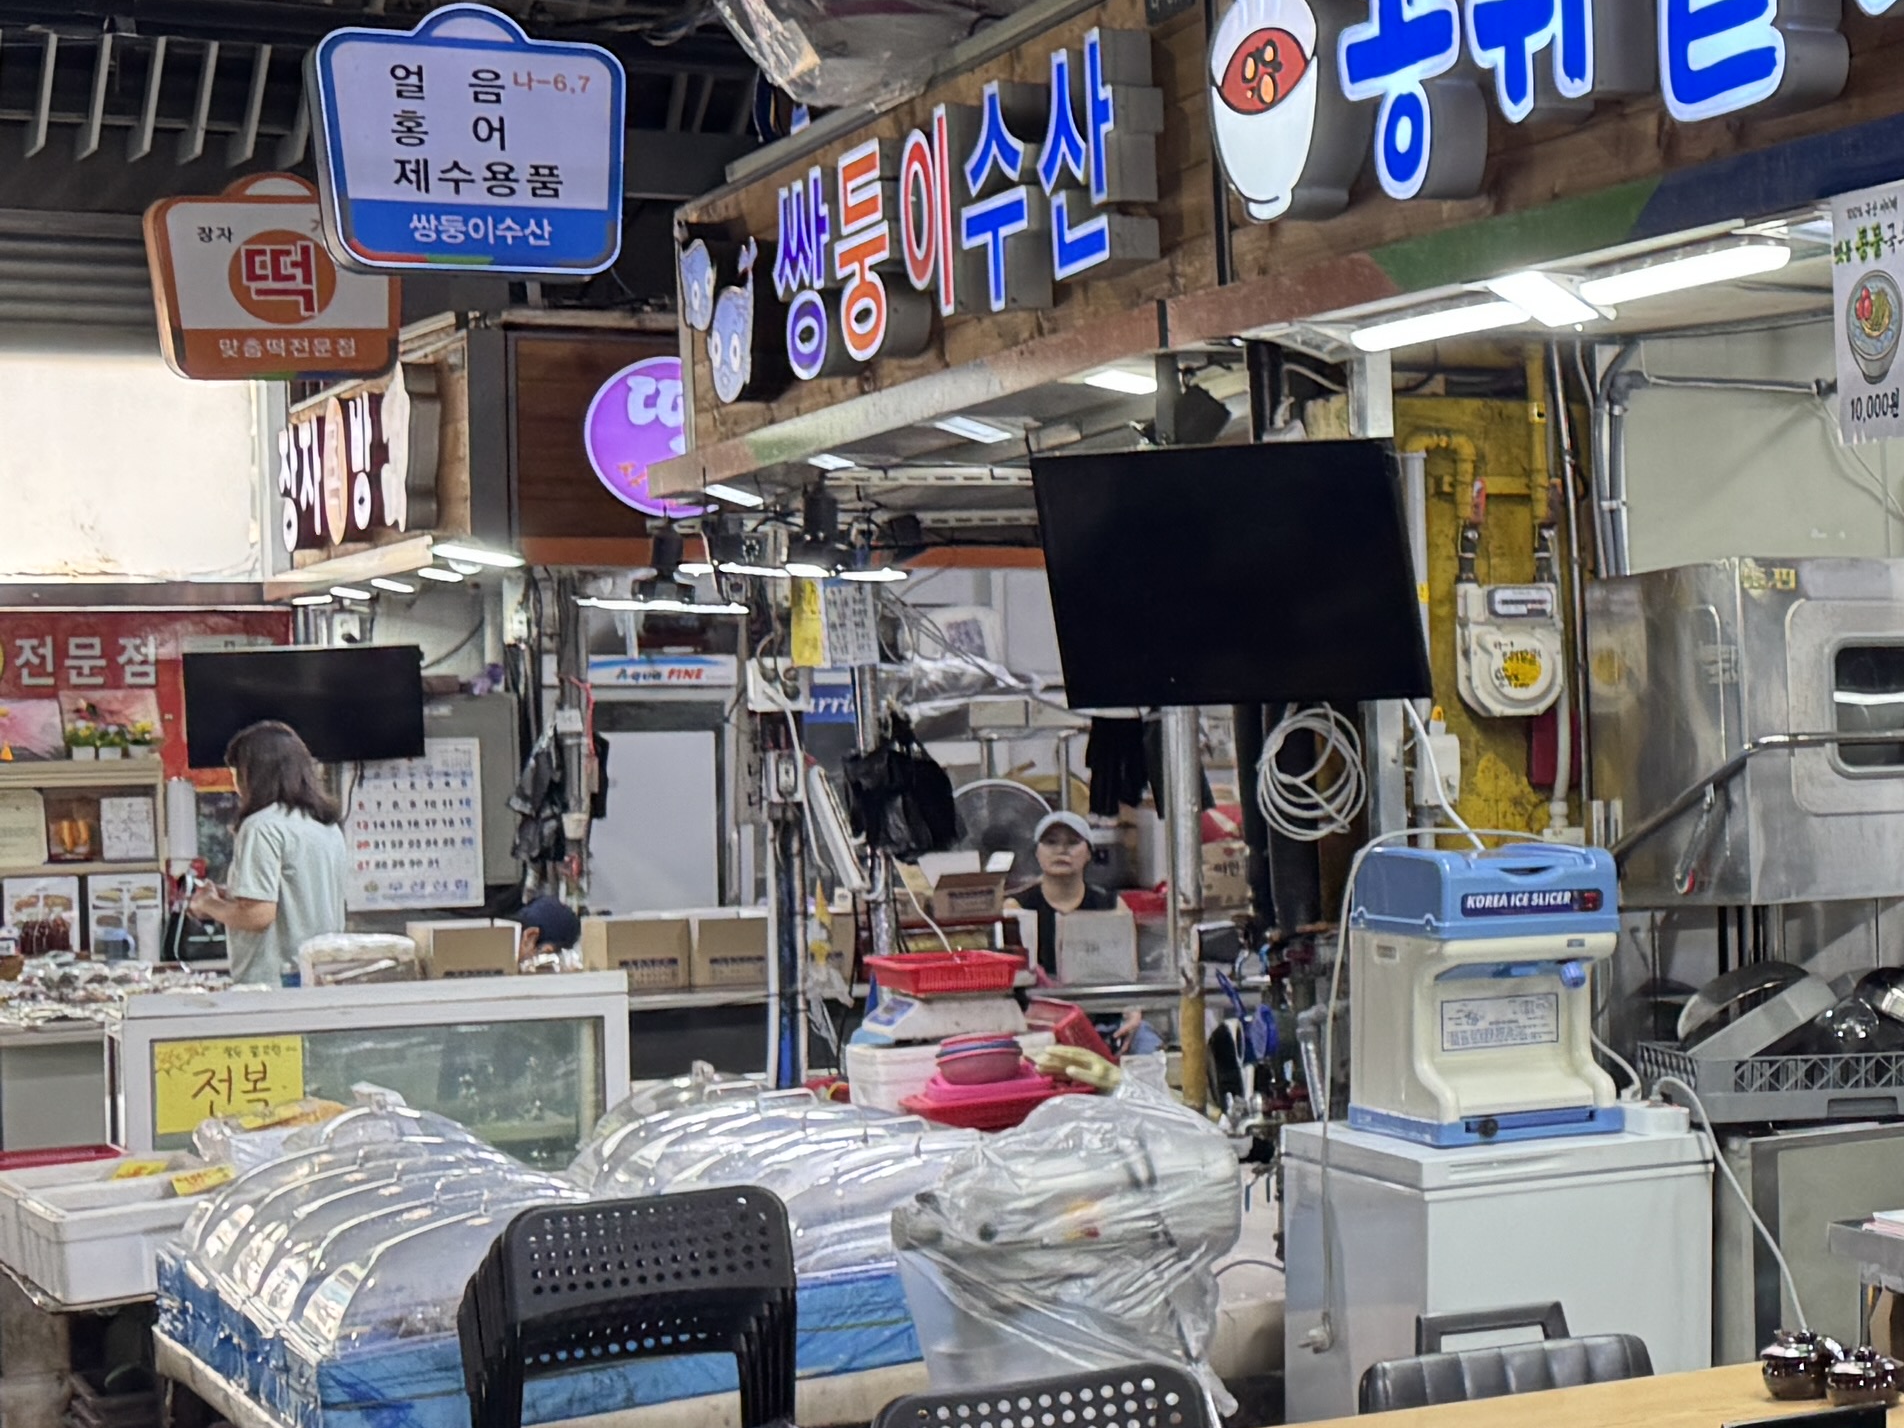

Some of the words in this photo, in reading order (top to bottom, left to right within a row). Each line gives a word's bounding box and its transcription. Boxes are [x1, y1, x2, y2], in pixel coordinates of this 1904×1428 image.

[393, 158, 563, 198] 제수용품
[772, 28, 1117, 380] 쌍둥이수산
[198, 227, 234, 243] 장자
[409, 214, 553, 246] 쌍둥이수산
[241, 241, 318, 317] 떡
[1850, 387, 1900, 423] 10,000원
[667, 668, 704, 680] FINE
[1466, 893, 1507, 909] KOREA
[1510, 892, 1529, 907] ICE
[1531, 891, 1572, 906] SLICER
